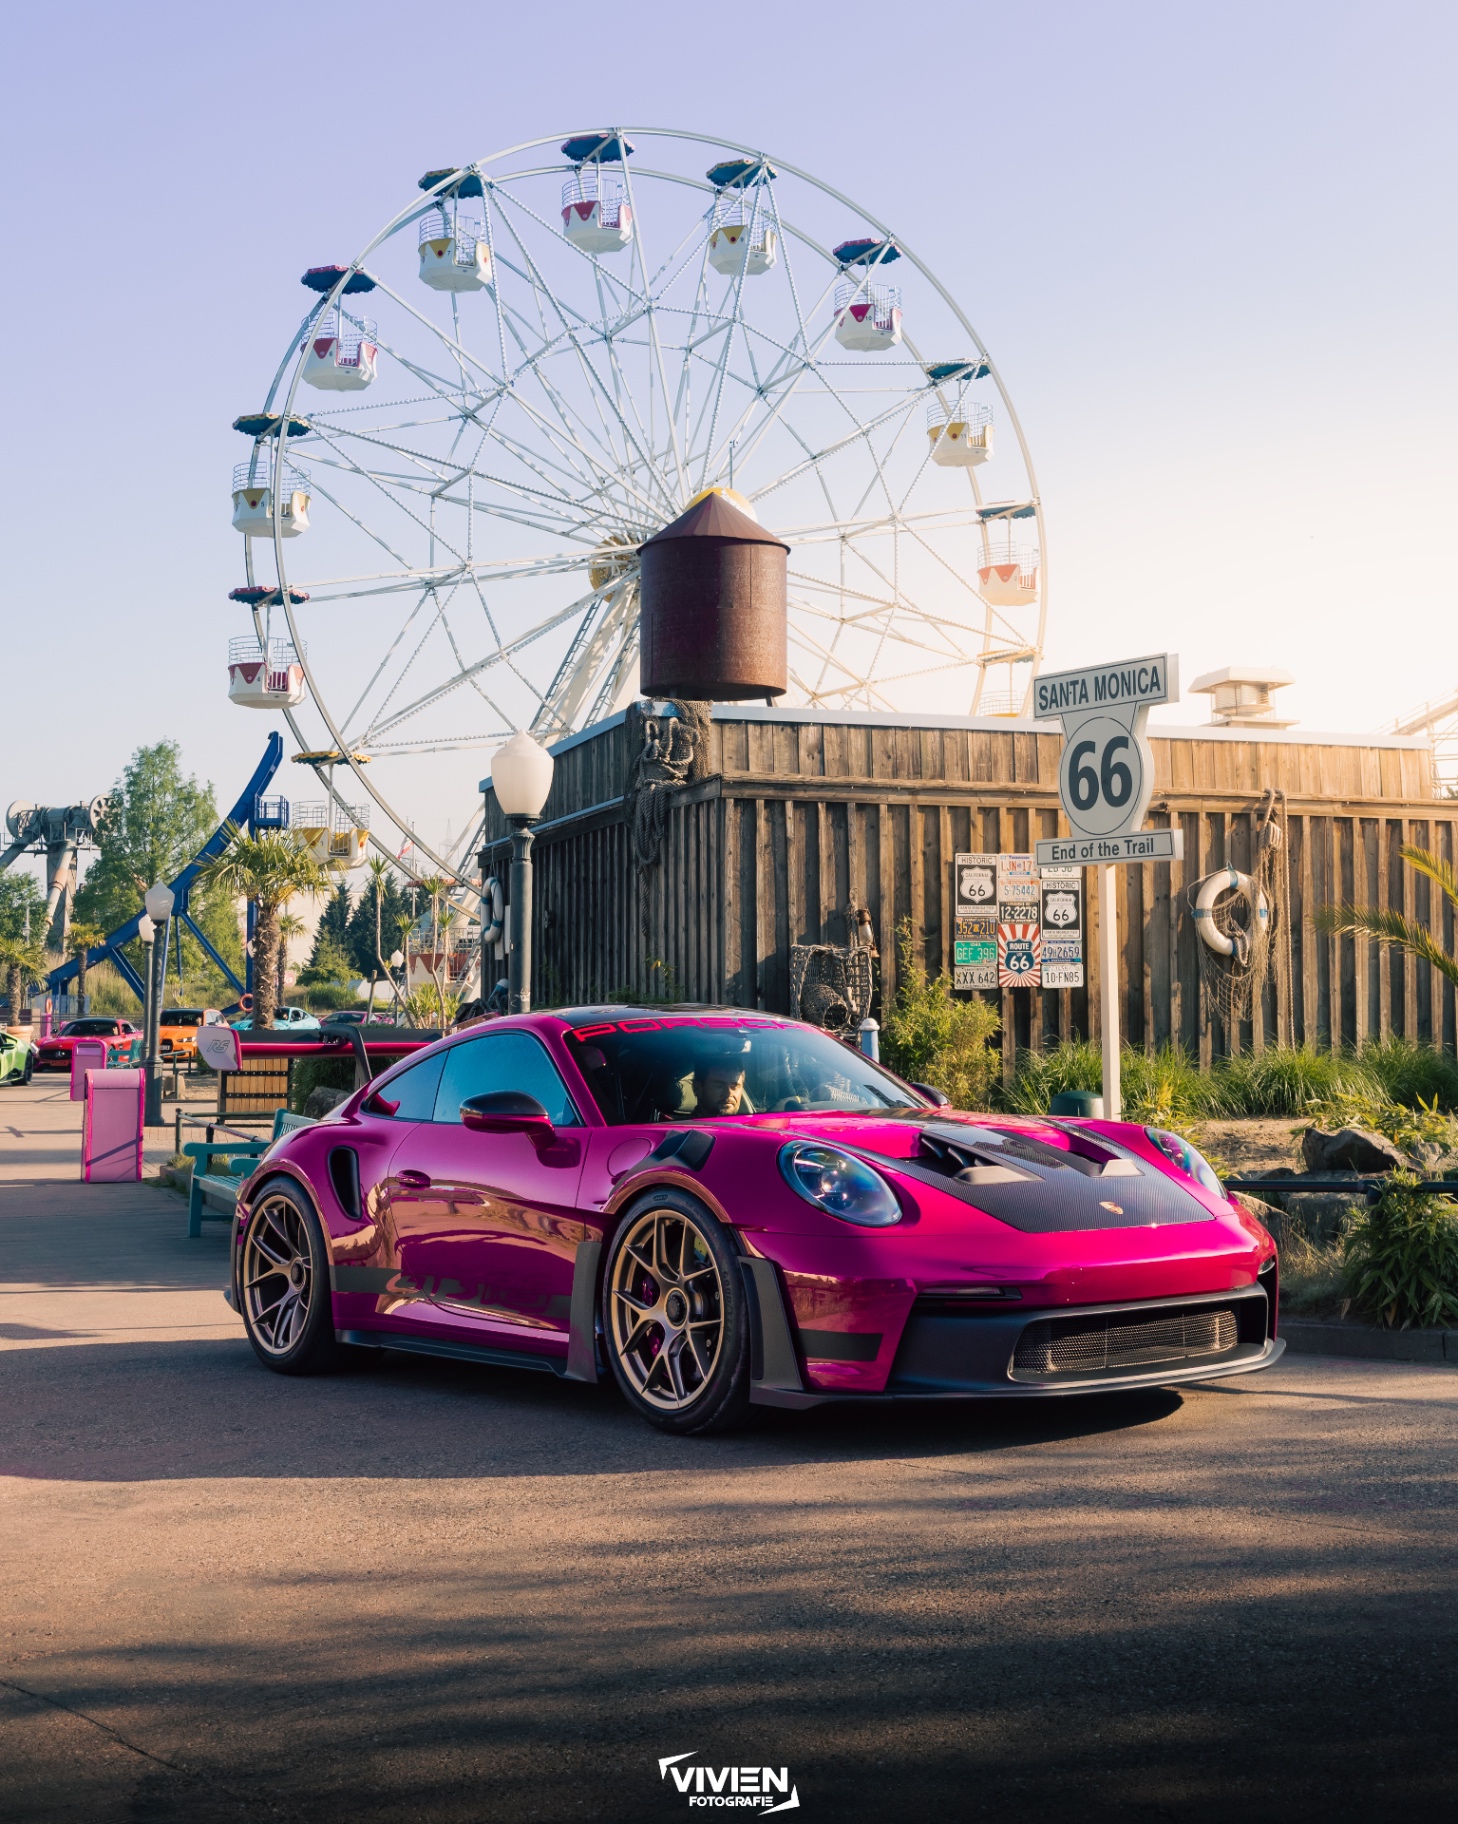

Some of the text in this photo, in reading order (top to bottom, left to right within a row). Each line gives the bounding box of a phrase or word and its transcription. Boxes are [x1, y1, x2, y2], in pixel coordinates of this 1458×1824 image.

[1039, 665, 1161, 711] SANTA MONICA
[1068, 735, 1133, 811] 66
[1052, 838, 1154, 860] End of the Trail
[961, 856, 993, 864] HISTORIC
[969, 884, 985, 897] 66
[1053, 909, 1070, 921] 66
[1010, 942, 1030, 950] ROUTE
[1010, 955, 1030, 970] 66
[978, 971, 995, 984] 642
[207, 1039, 230, 1053] RS
